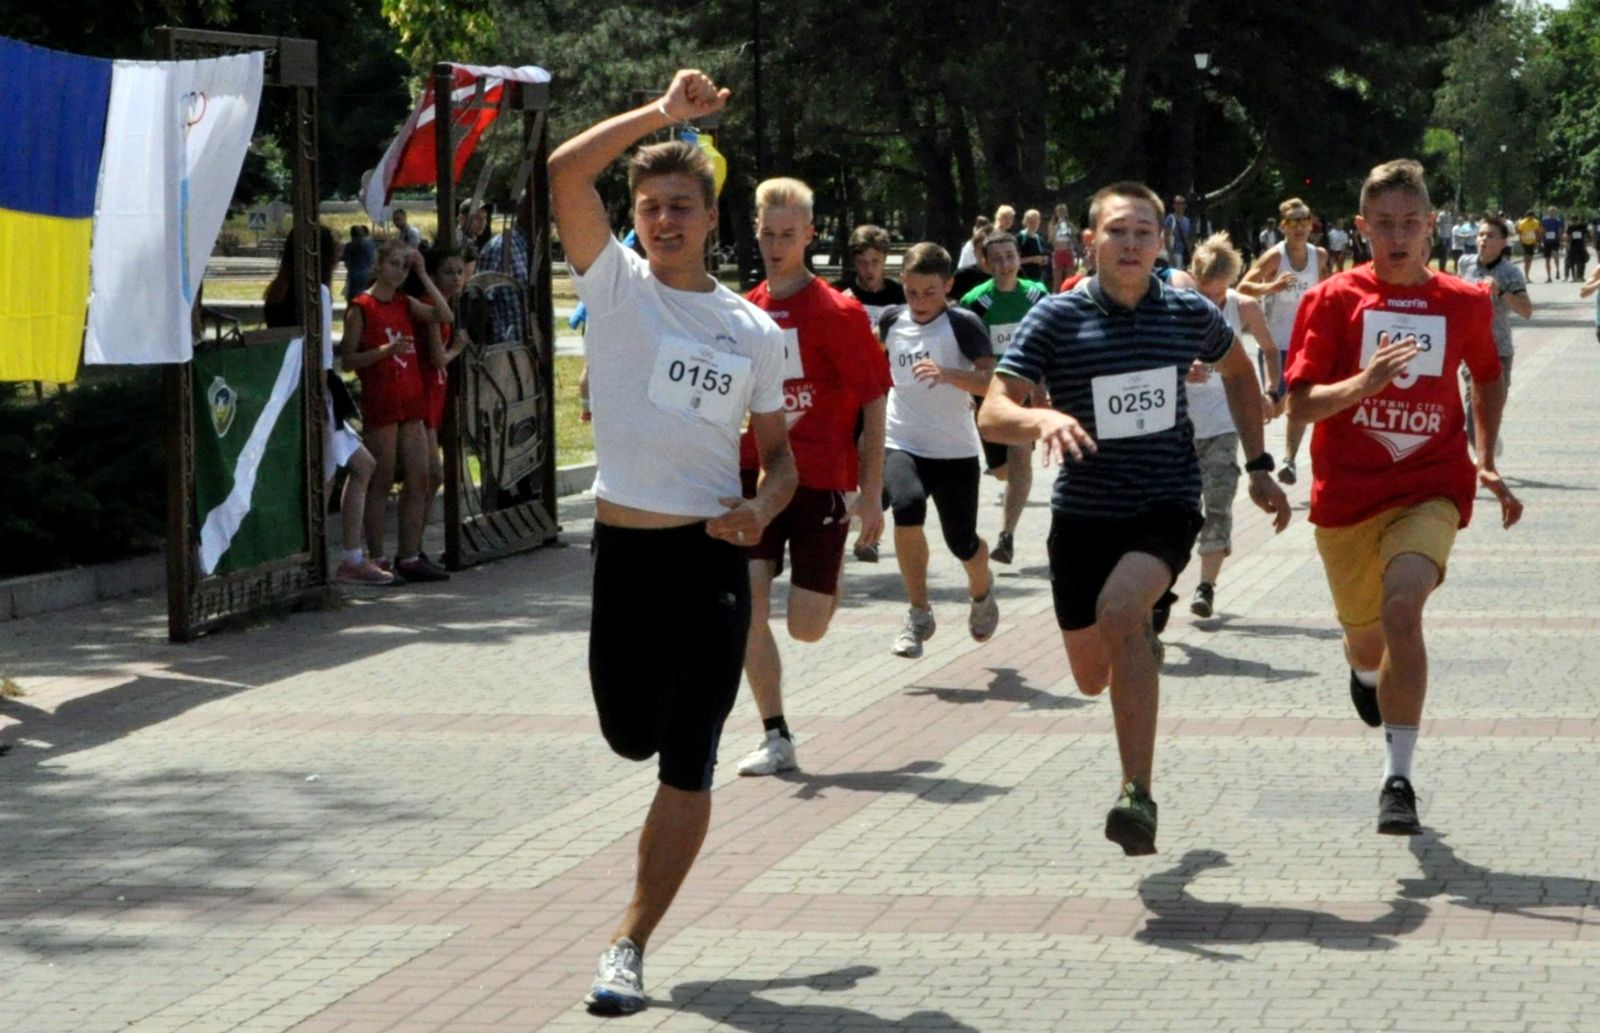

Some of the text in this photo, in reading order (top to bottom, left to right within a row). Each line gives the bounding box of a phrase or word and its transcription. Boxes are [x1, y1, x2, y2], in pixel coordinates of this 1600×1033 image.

[669, 360, 733, 396] 0153
[1108, 388, 1166, 415] 0253
[1352, 405, 1441, 433] ALTIOR
